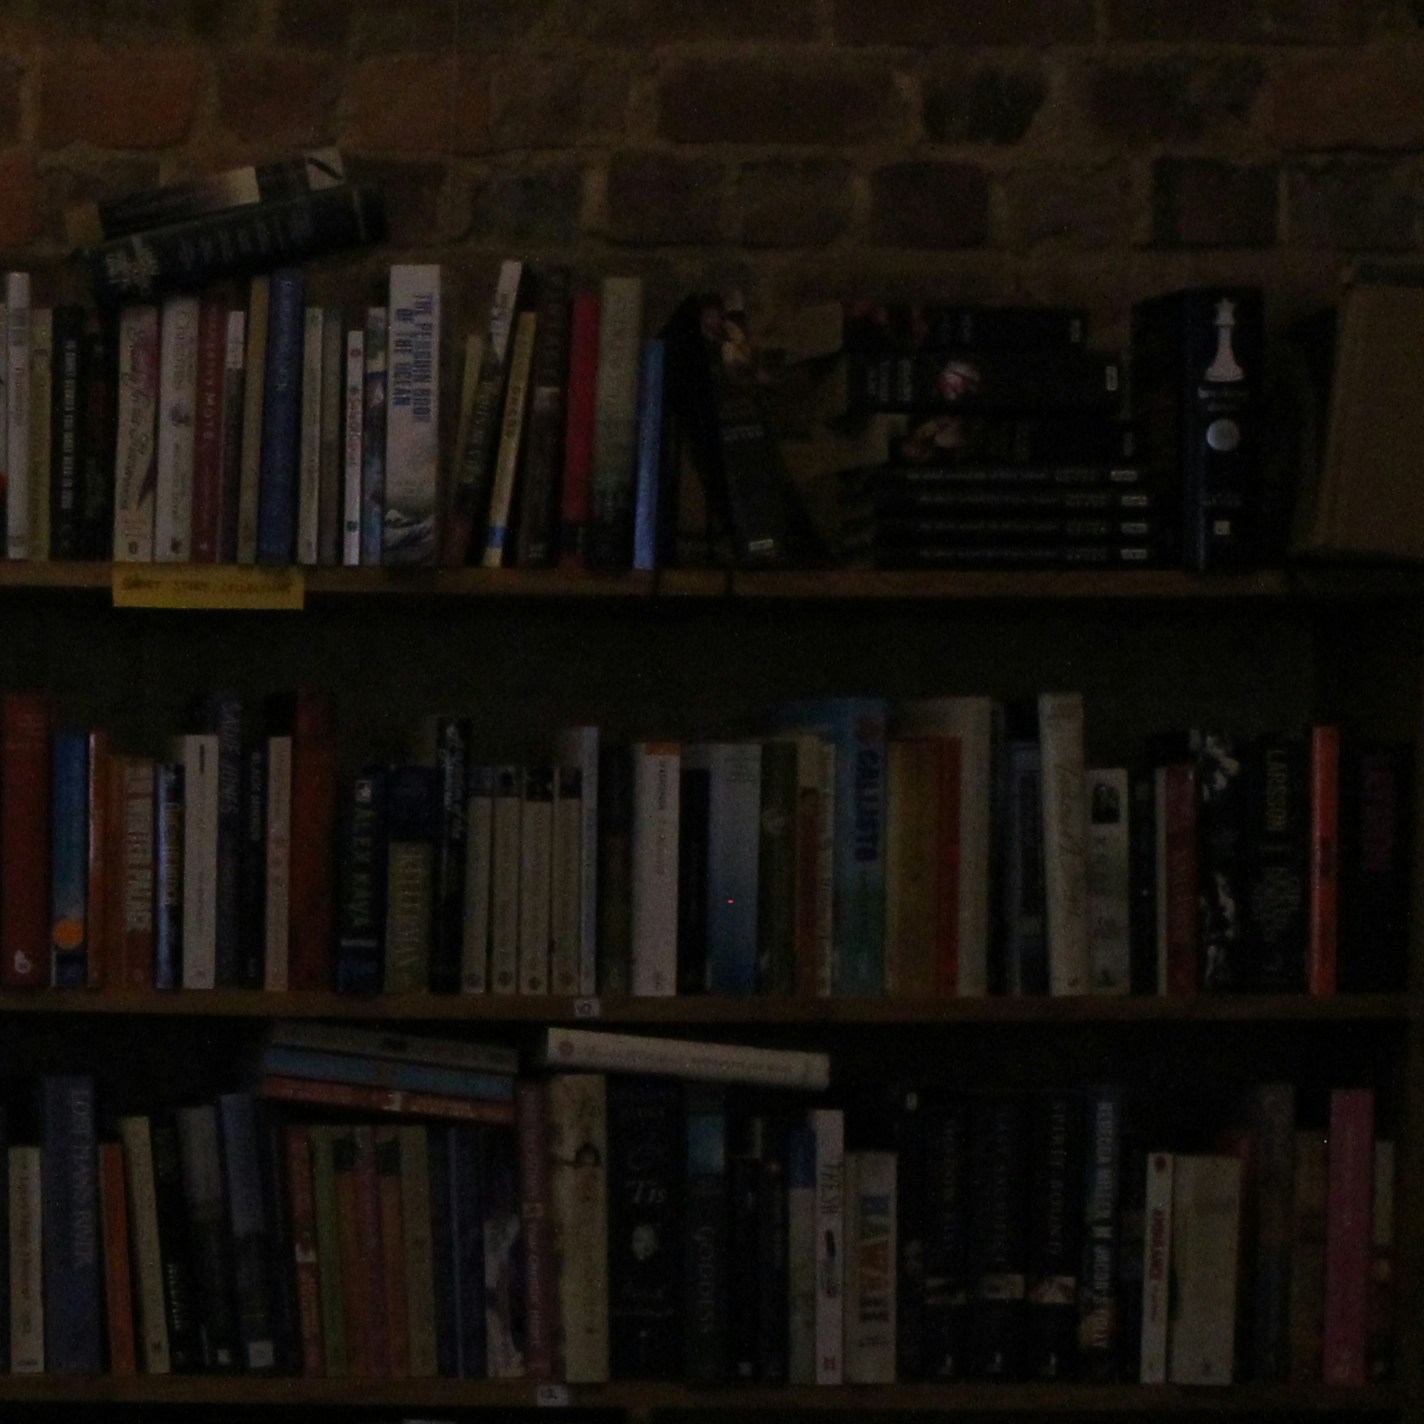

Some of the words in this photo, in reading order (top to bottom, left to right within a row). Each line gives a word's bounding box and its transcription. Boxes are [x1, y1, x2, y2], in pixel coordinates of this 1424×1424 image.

[411, 322, 434, 383] PENGUIN
[854, 749, 881, 864] CALLISTO
[1264, 748, 1287, 832] LARSSON
[351, 806, 375, 863] ALEX
[349, 871, 373, 929] KAVA
[70, 1088, 94, 1138] LOST
[1048, 1102, 1068, 1167] SPIRIT
[1047, 1178, 1066, 1256] BOUND
[691, 1224, 716, 1335] GODDESS
